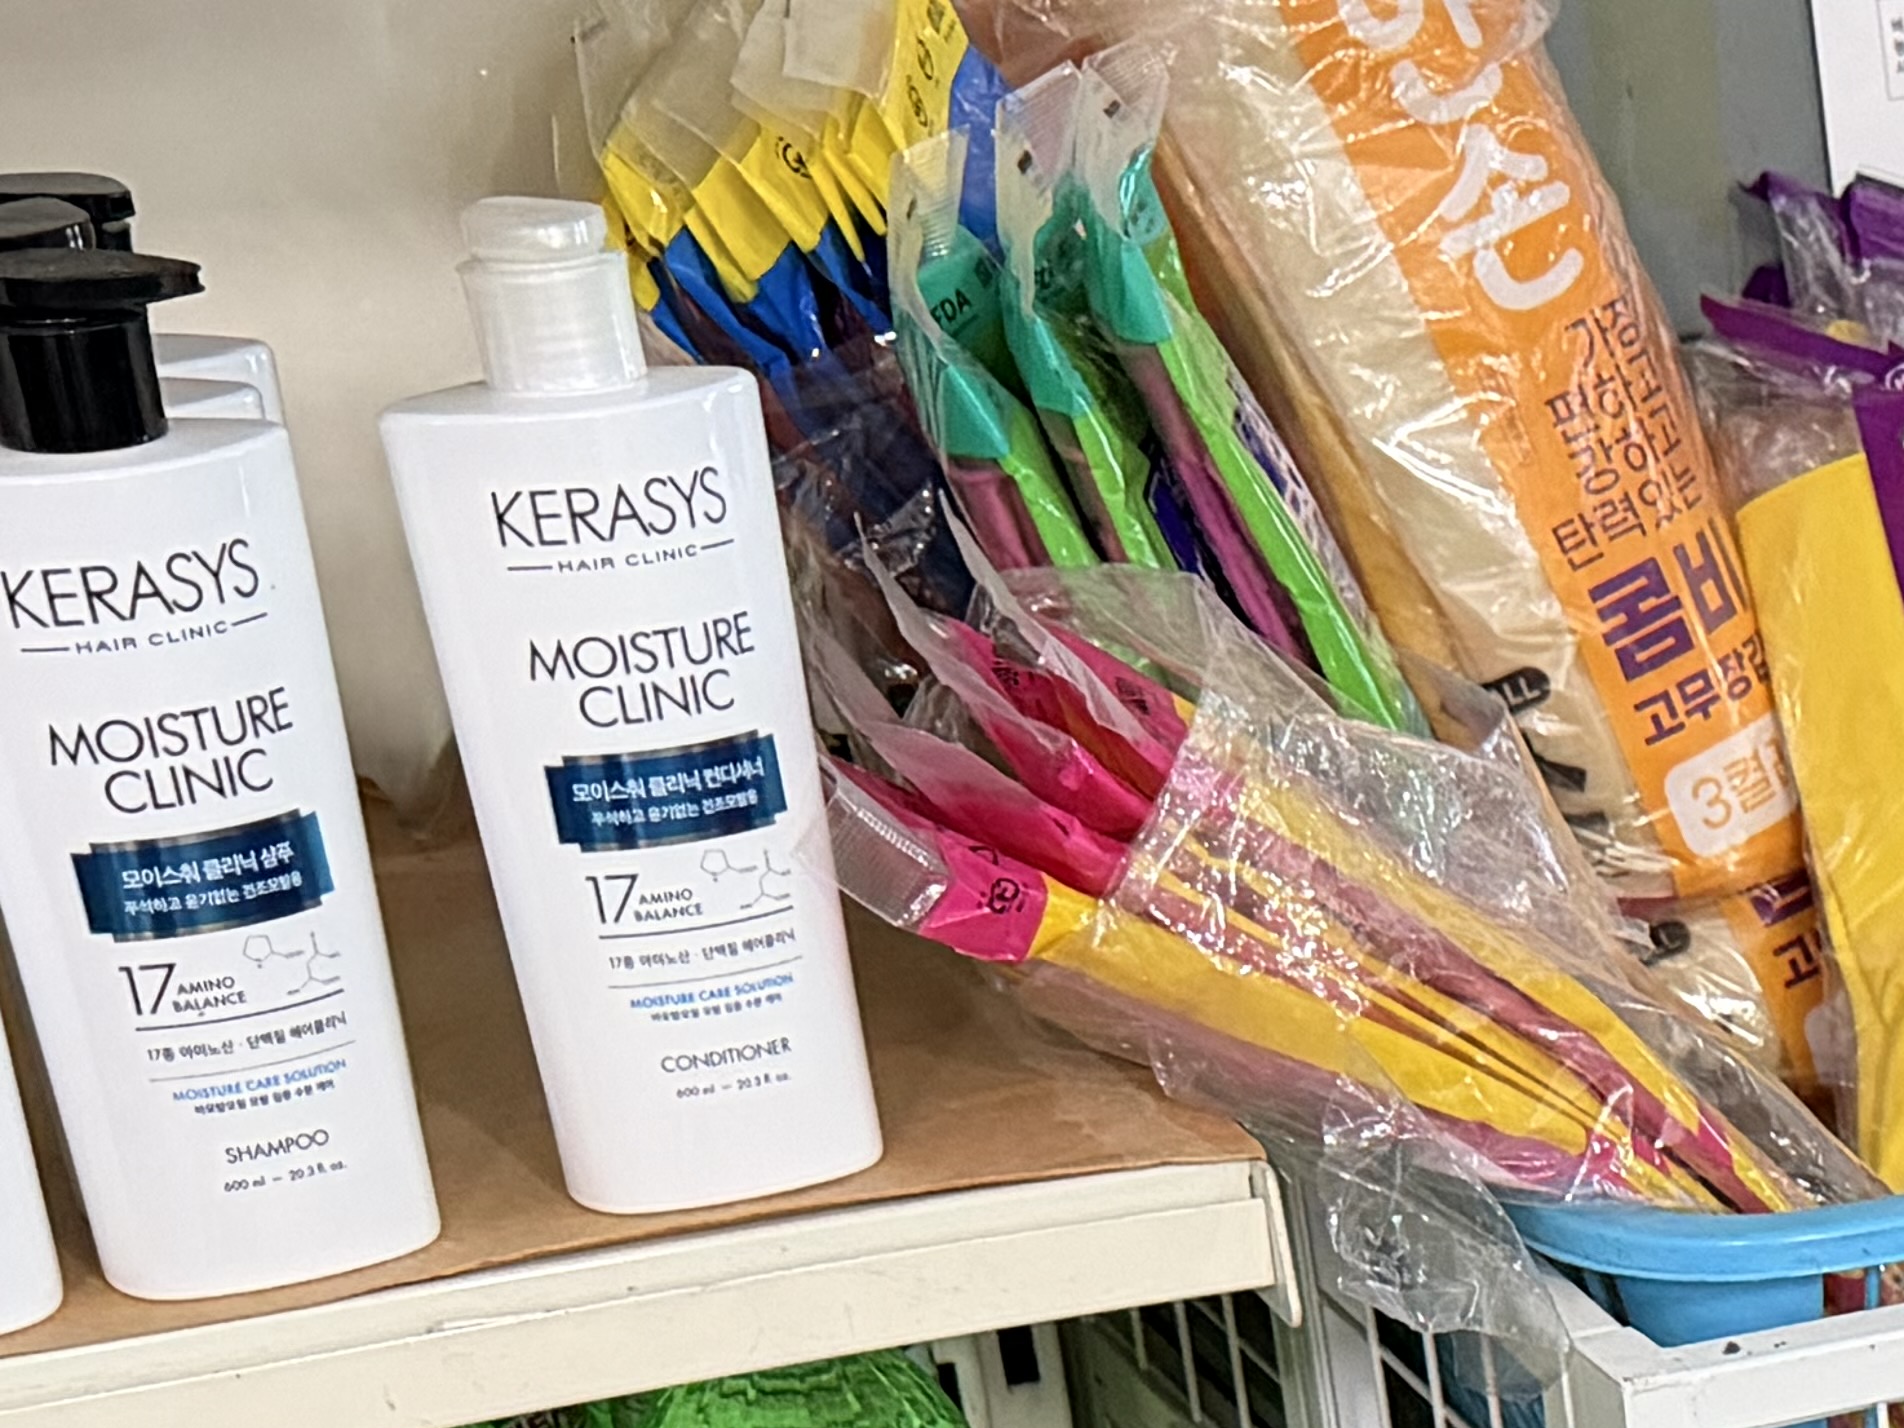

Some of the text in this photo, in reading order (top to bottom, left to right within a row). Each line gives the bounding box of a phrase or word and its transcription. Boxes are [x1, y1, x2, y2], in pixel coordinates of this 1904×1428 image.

[491, 466, 727, 548] KERASYS
[557, 543, 700, 574] HAIR CLINIC
[1, 538, 259, 629] KERASYS
[75, 621, 230, 656] HAIR CLINIC
[530, 611, 755, 682] MOISTURE
[579, 668, 736, 728] CLINIC
[48, 687, 294, 767] MOISTURE
[105, 749, 274, 814] CLINIC
[648, 767, 702, 799] 클리닉
[702, 756, 766, 789] 컨디셔너
[203, 850, 261, 883] 클리닉
[260, 840, 296, 869] 샴푸
[584, 872, 640, 925] 17
[633, 901, 704, 924] BALANCE
[638, 887, 693, 906] AMINO
[118, 962, 177, 1017] 17
[172, 991, 248, 1014] BALANCE
[177, 975, 236, 998] AMINO
[630, 971, 794, 1010] MOISTURE CARE SOLUTION
[660, 1036, 793, 1074] CONDITIONER
[172, 1058, 347, 1103] MOISTURE CARE SOLUTION
[225, 1129, 330, 1165] SHAMPOO
[223, 1179, 249, 1194] 600
